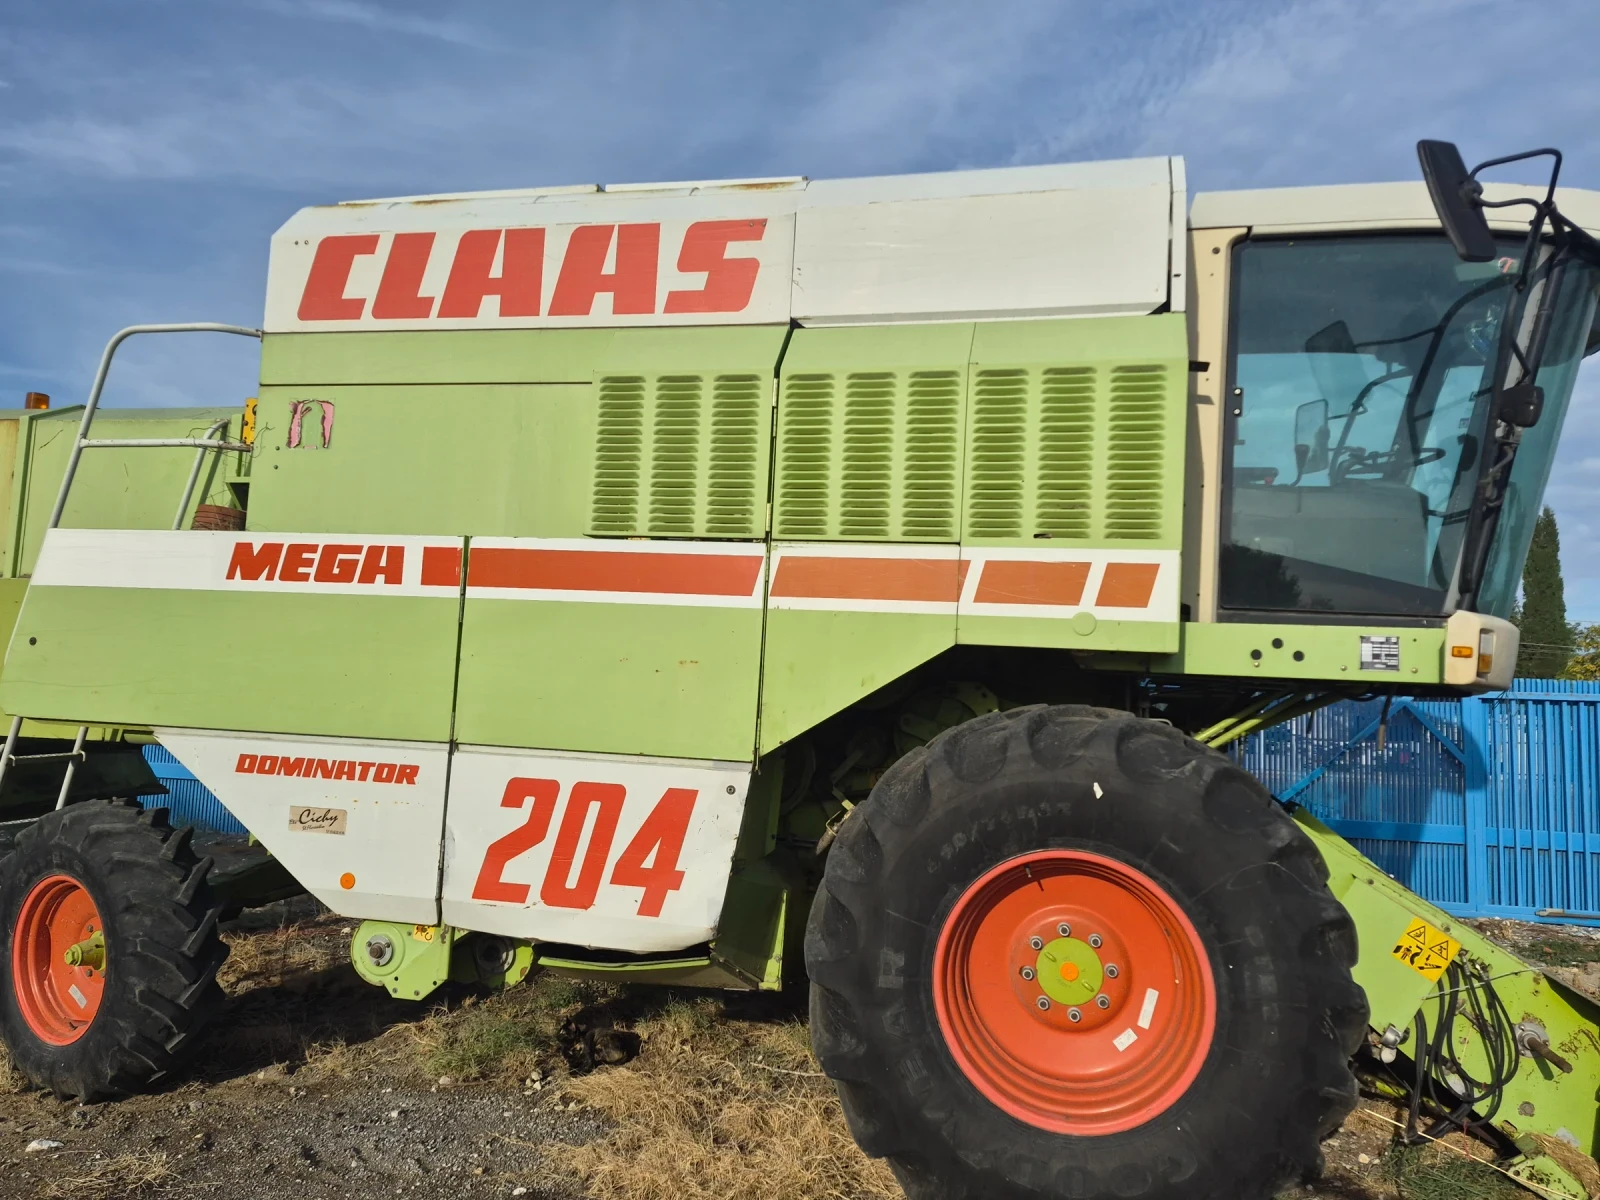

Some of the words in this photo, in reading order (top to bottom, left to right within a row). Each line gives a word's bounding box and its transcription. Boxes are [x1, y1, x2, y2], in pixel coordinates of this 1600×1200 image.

[297, 218, 767, 321] CLAAS
[225, 541, 405, 586] MEGA
[235, 752, 420, 786] DOMINATOR
[298, 808, 338, 827] Cichy
[471, 776, 699, 918] 204
